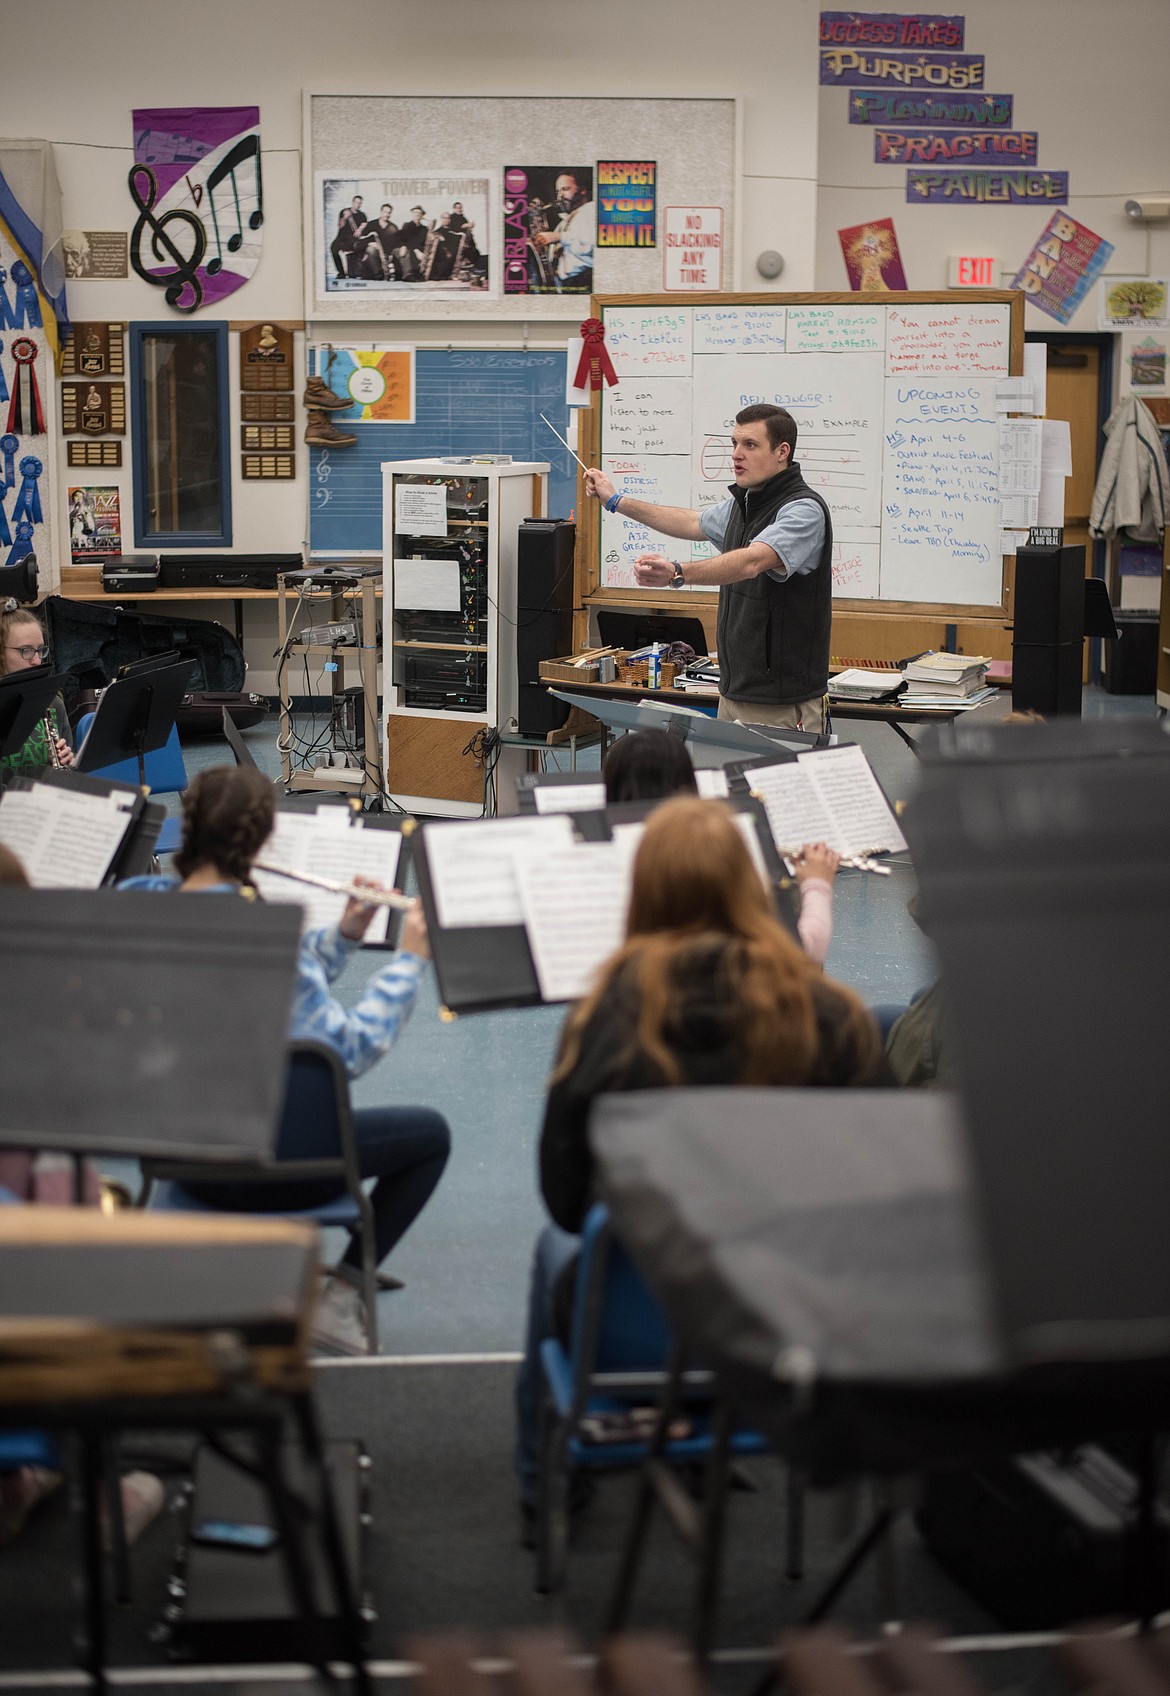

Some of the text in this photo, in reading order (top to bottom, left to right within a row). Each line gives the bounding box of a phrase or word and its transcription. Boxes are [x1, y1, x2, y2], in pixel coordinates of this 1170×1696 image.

[820, 18, 897, 43] UCCESS
[823, 51, 983, 90] PURPOSE
[853, 92, 1009, 123] PLANNING
[876, 130, 1035, 162] PRACTICE
[599, 162, 655, 185] RESPECT
[382, 181, 428, 196] TOWER
[438, 180, 487, 195] POWER
[908, 172, 1066, 202] PATIENCE
[600, 198, 653, 211] YOU
[685, 215, 702, 229] NO
[599, 223, 635, 246] EARN
[666, 233, 720, 248] SLACKING
[682, 251, 705, 265] ANY
[679, 269, 706, 283] TIME
[959, 257, 995, 285] EXIT
[609, 318, 624, 328] HS
[928, 315, 961, 328] cannot
[967, 314, 1001, 326] dream
[890, 331, 929, 343] yourself
[935, 331, 956, 339] into
[953, 341, 972, 350] you
[976, 339, 1003, 348] must
[889, 352, 925, 361] hammer
[932, 352, 948, 360] and
[922, 363, 942, 371] into
[613, 392, 623, 402] I
[897, 387, 981, 403] UPCOMING
[609, 405, 636, 416] listen
[639, 407, 649, 416] to
[919, 404, 979, 415] EVENTS
[610, 423, 659, 436] than just
[823, 419, 869, 428] EXAMPLE
[621, 439, 665, 450] my part
[886, 430, 903, 444] HS
[910, 434, 934, 446] April
[897, 450, 928, 459] District
[932, 451, 957, 459] Music
[901, 461, 923, 470] Piano
[929, 463, 948, 474] April
[935, 477, 954, 487] April
[92, 494, 119, 510] JAZZ
[943, 492, 961, 502] April
[886, 503, 900, 514] HS
[908, 506, 931, 519] April
[901, 523, 931, 533] Seattle
[933, 524, 954, 535] Trip
[1030, 528, 1059, 537] I'M KIND OF
[628, 532, 651, 542] AIR
[898, 534, 922, 545] Leave
[926, 537, 942, 547] TBD
[1030, 536, 1035, 545] A
[1036, 536, 1045, 545] BIG
[1046, 537, 1059, 546] DEAL
[622, 542, 666, 553] GREATEST
[694, 541, 709, 552] HS
[330, 625, 348, 635] LHS
